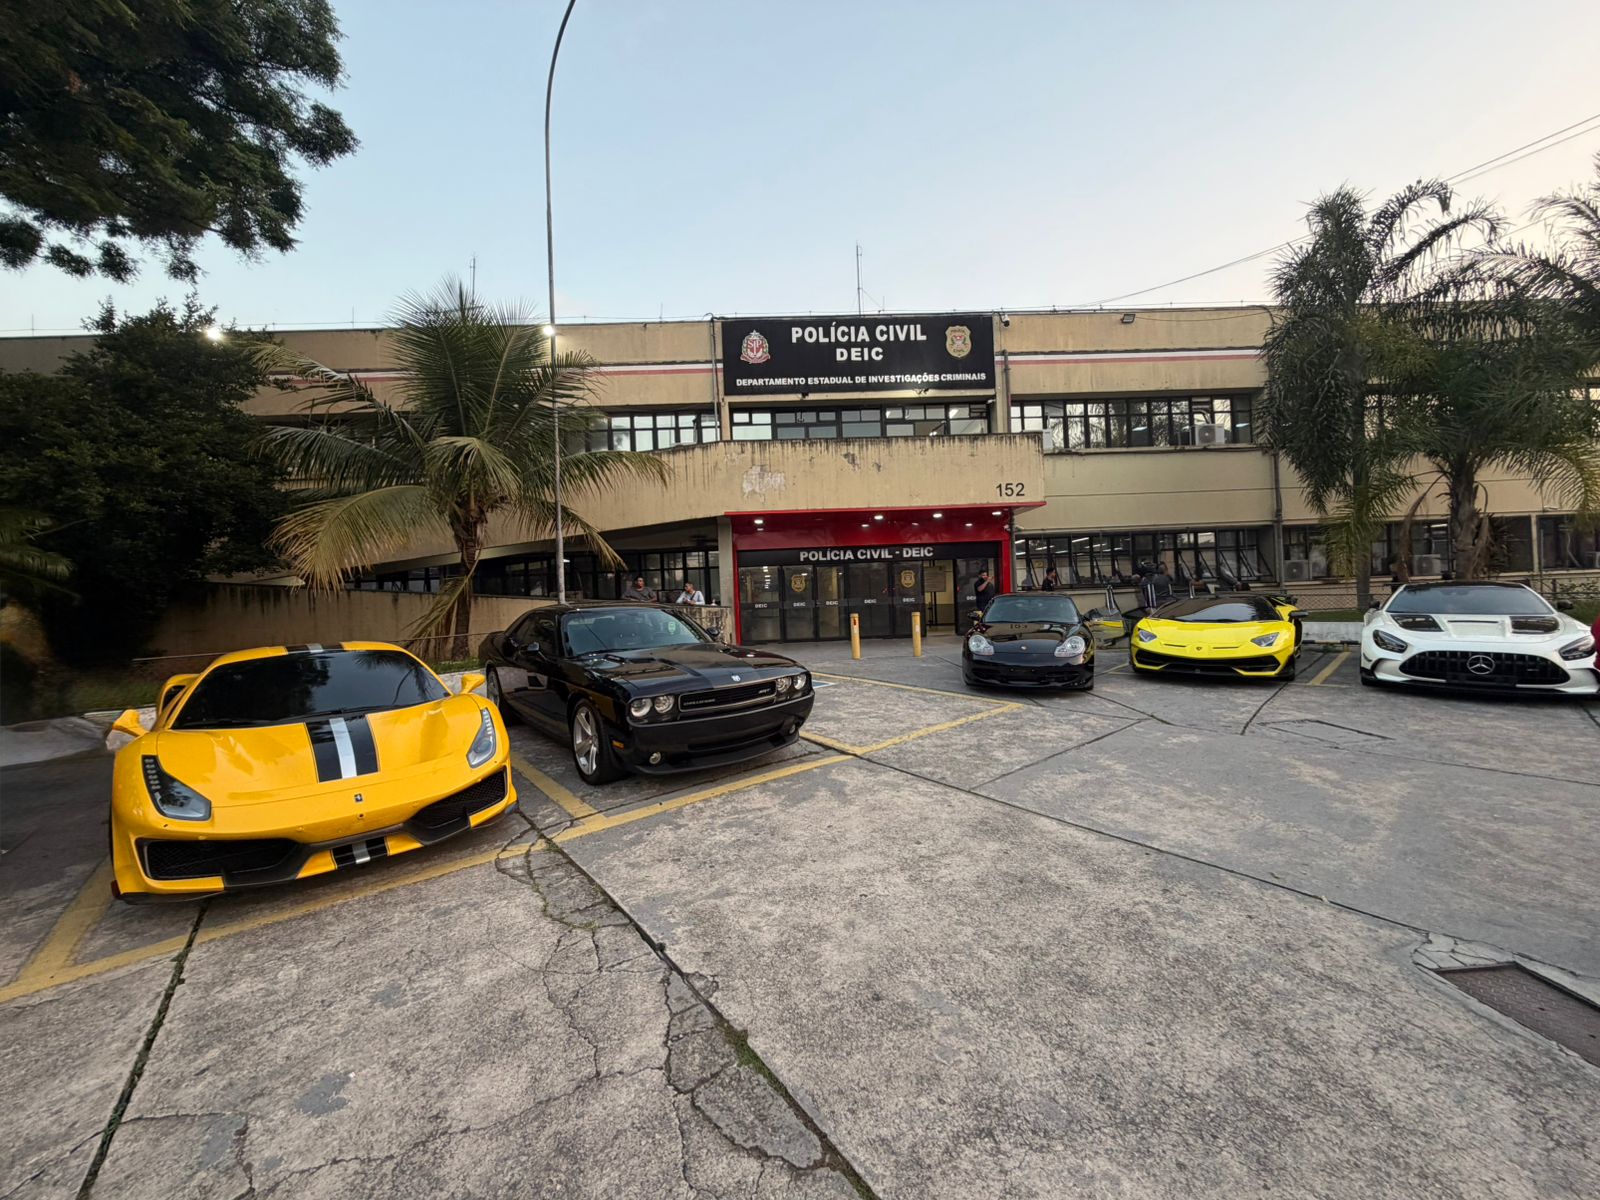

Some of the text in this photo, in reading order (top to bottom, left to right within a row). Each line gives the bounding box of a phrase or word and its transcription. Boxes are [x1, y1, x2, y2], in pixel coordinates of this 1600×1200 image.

[791, 322, 927, 343] POLÍCIA CIVIL
[836, 347, 884, 361] DEIC
[736, 372, 986, 387] DEPARTAMENTO ESTADUAL DE INVESTIGAÇÕES CRIMINAIS
[996, 482, 1025, 497] 152
[799, 548, 855, 562] POLÍCIA
[857, 549, 893, 560] CIVIL
[902, 547, 934, 558] DEIC
